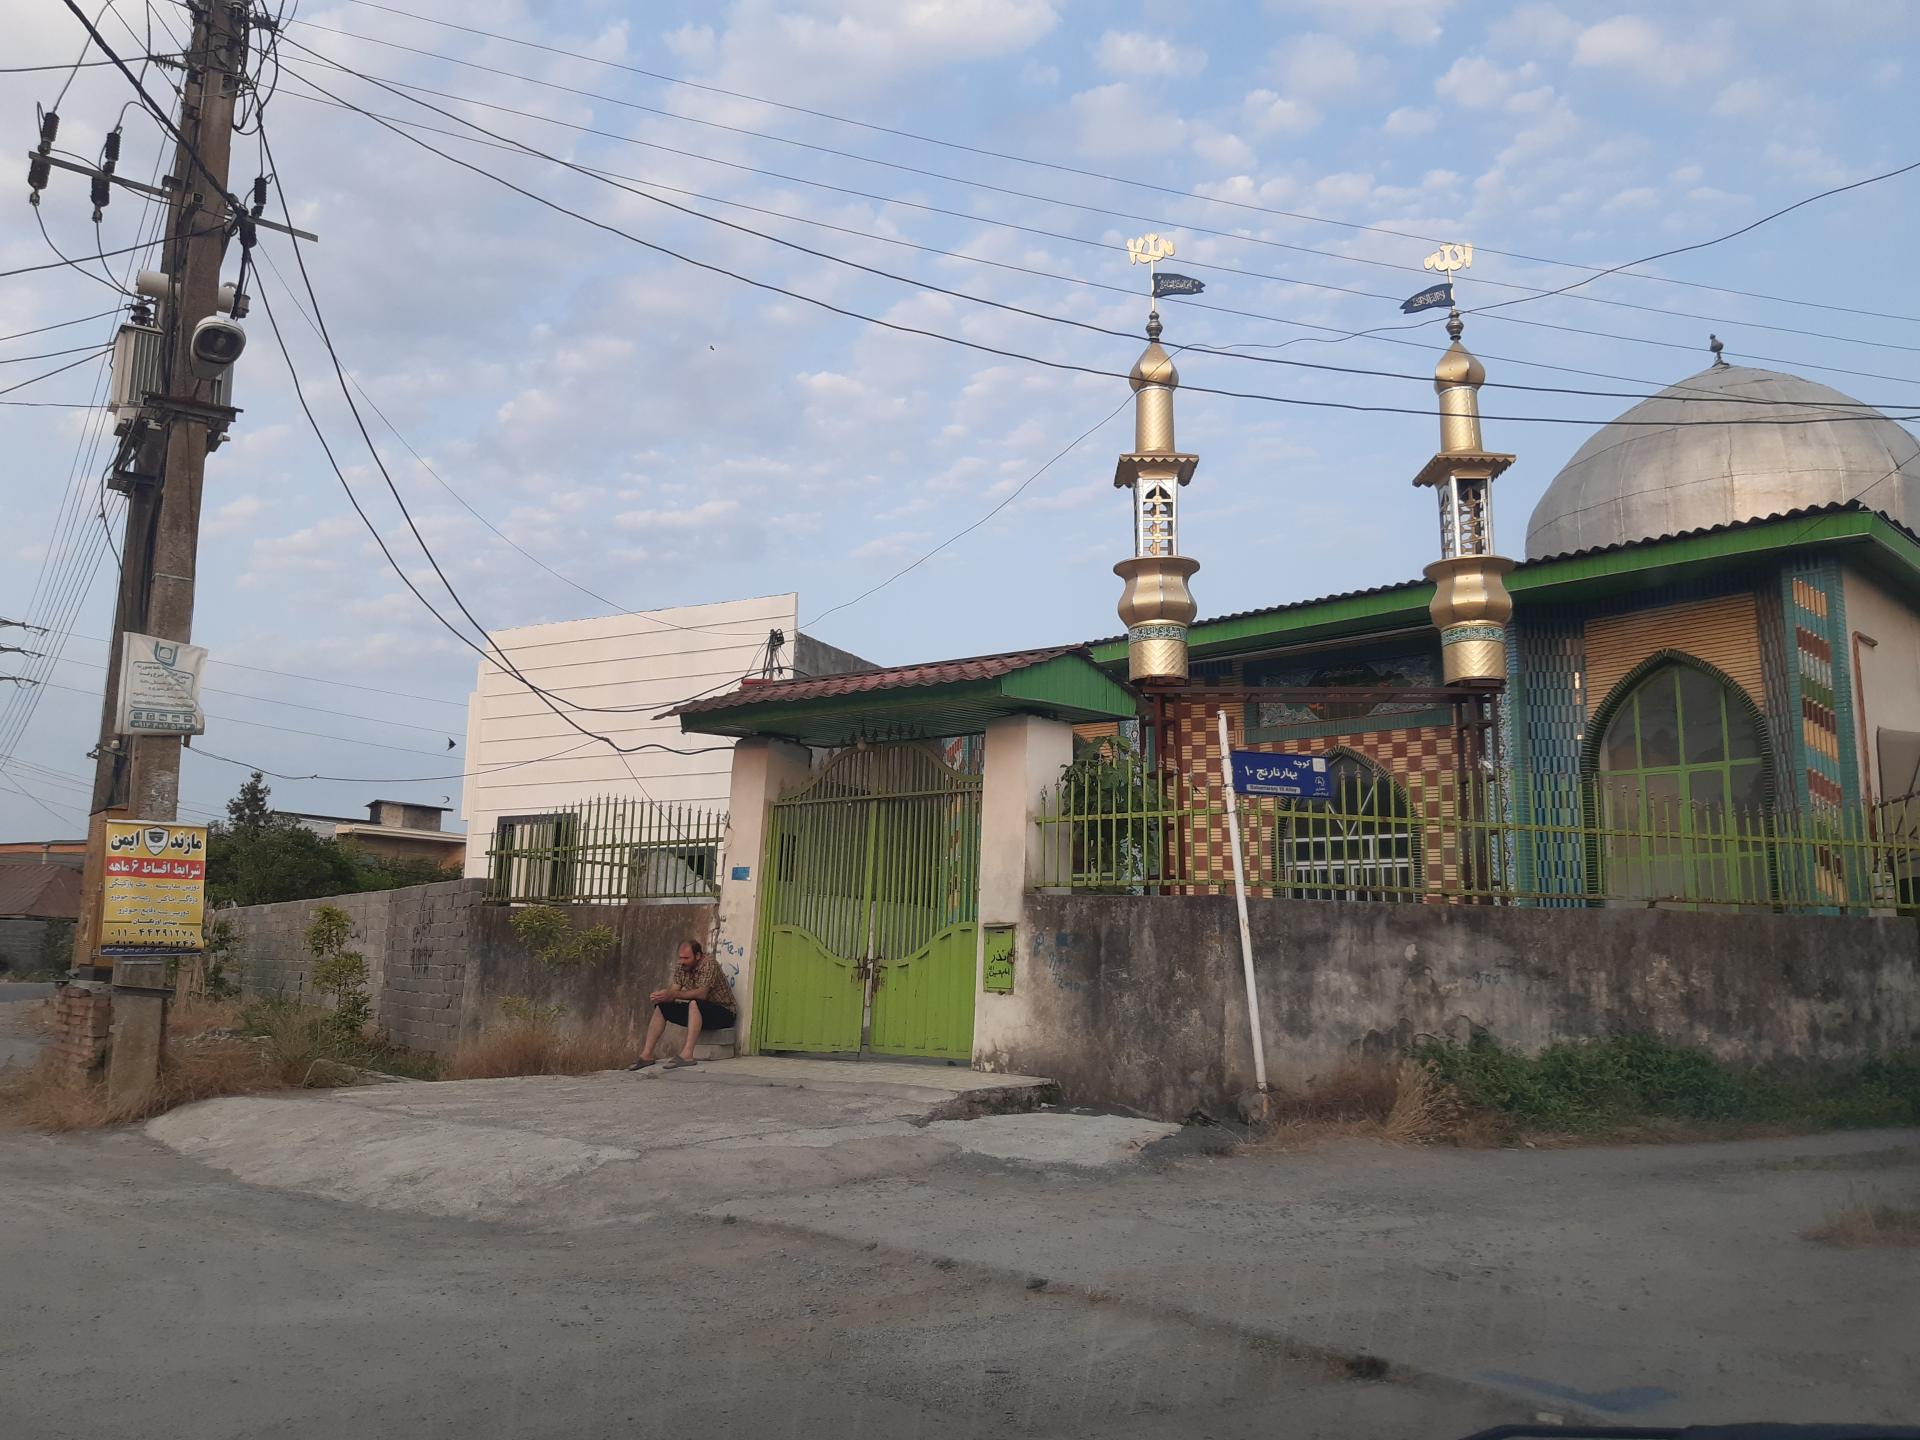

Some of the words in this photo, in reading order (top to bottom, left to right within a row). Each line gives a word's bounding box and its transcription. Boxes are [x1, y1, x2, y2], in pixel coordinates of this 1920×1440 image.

[1424, 241, 1473, 271] الله
[1244, 765, 1254, 776] ۱۰
[1293, 759, 1311, 769] کوچه
[110, 830, 140, 851] ایمن
[171, 831, 202, 854] مازند
[108, 859, 130, 872] ماهه
[131, 860, 139, 872] ۶
[142, 861, 171, 874] اقساط
[172, 861, 201, 878] شرایط
